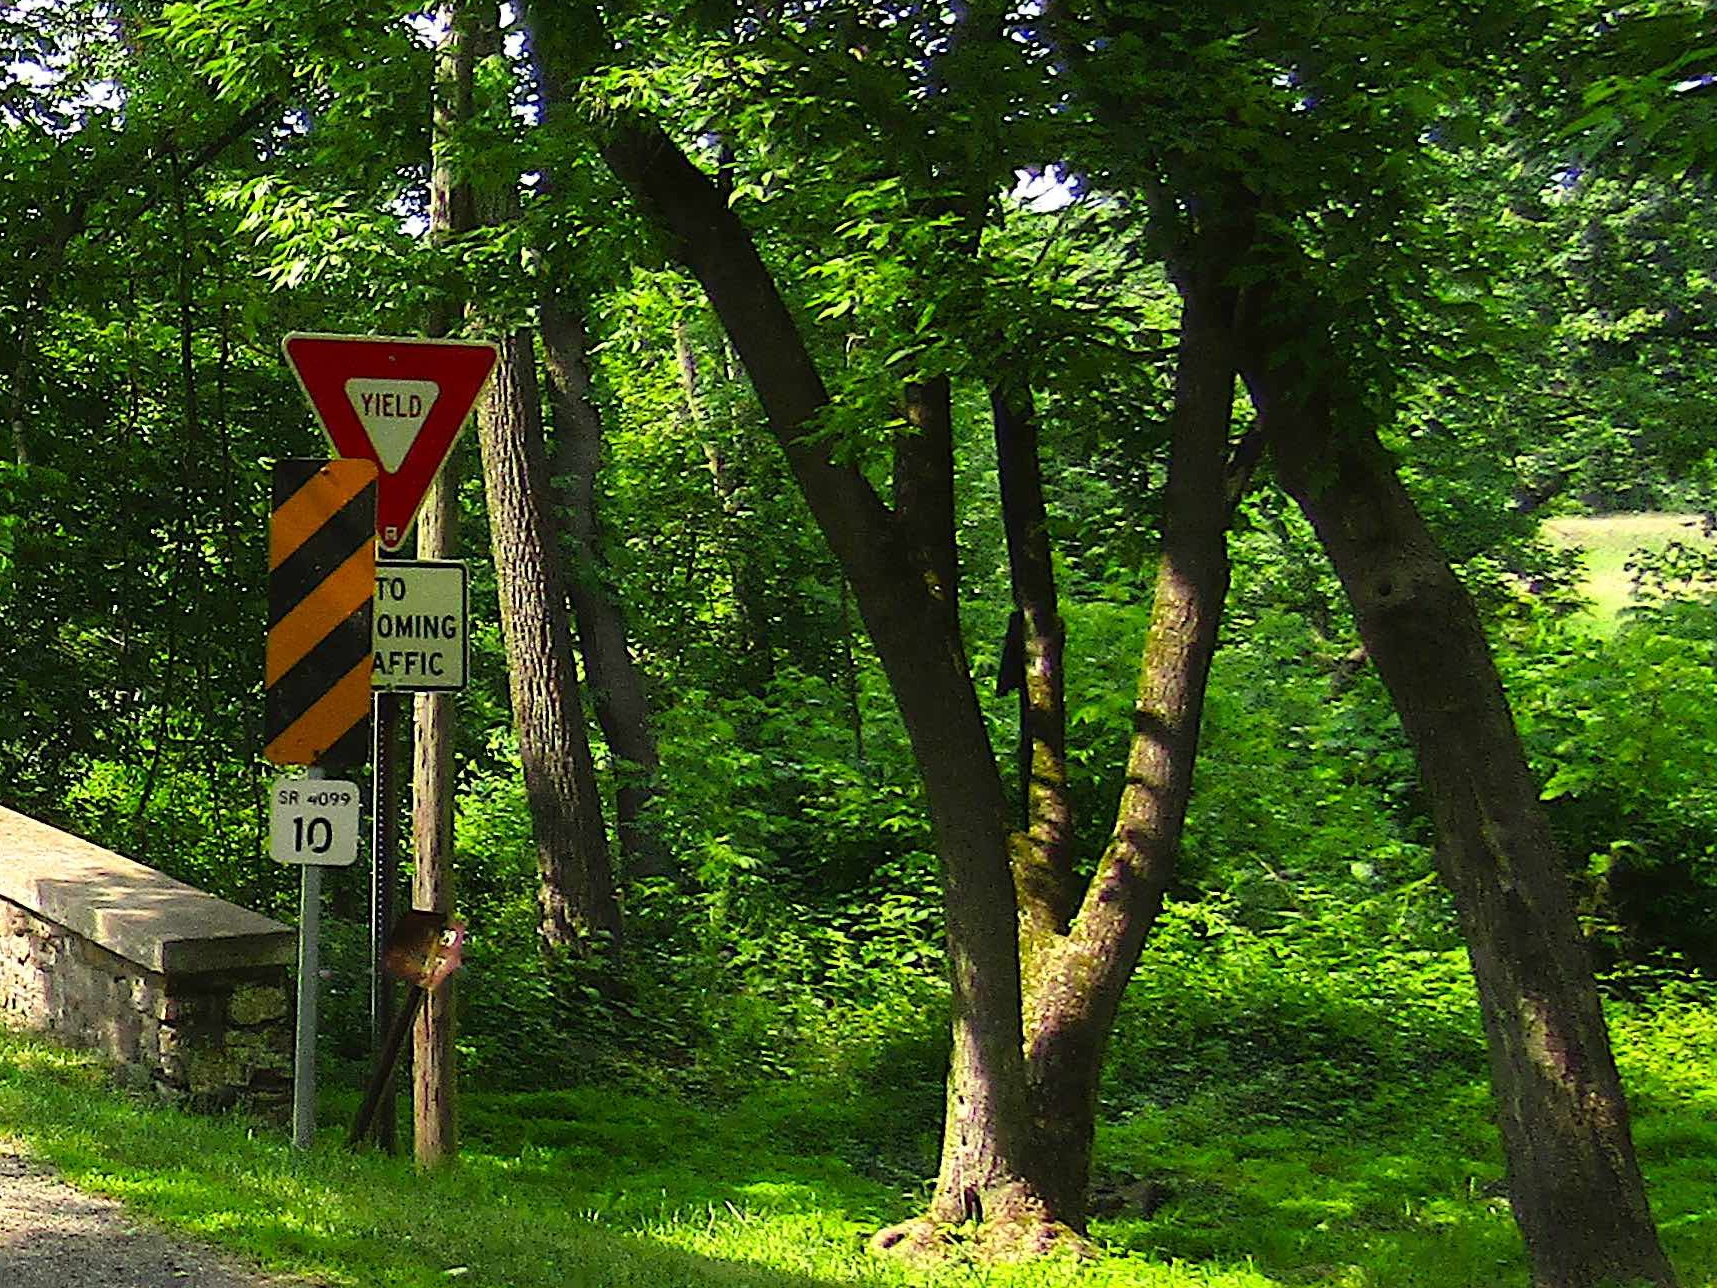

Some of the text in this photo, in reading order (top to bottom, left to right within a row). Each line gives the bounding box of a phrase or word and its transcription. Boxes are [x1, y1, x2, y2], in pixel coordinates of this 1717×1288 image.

[361, 393, 422, 418] YIELD
[374, 577, 406, 601] TO
[377, 614, 457, 639] OMING
[373, 652, 444, 676] AFFIC
[278, 790, 351, 807] SR 4099
[293, 816, 333, 853] 10
